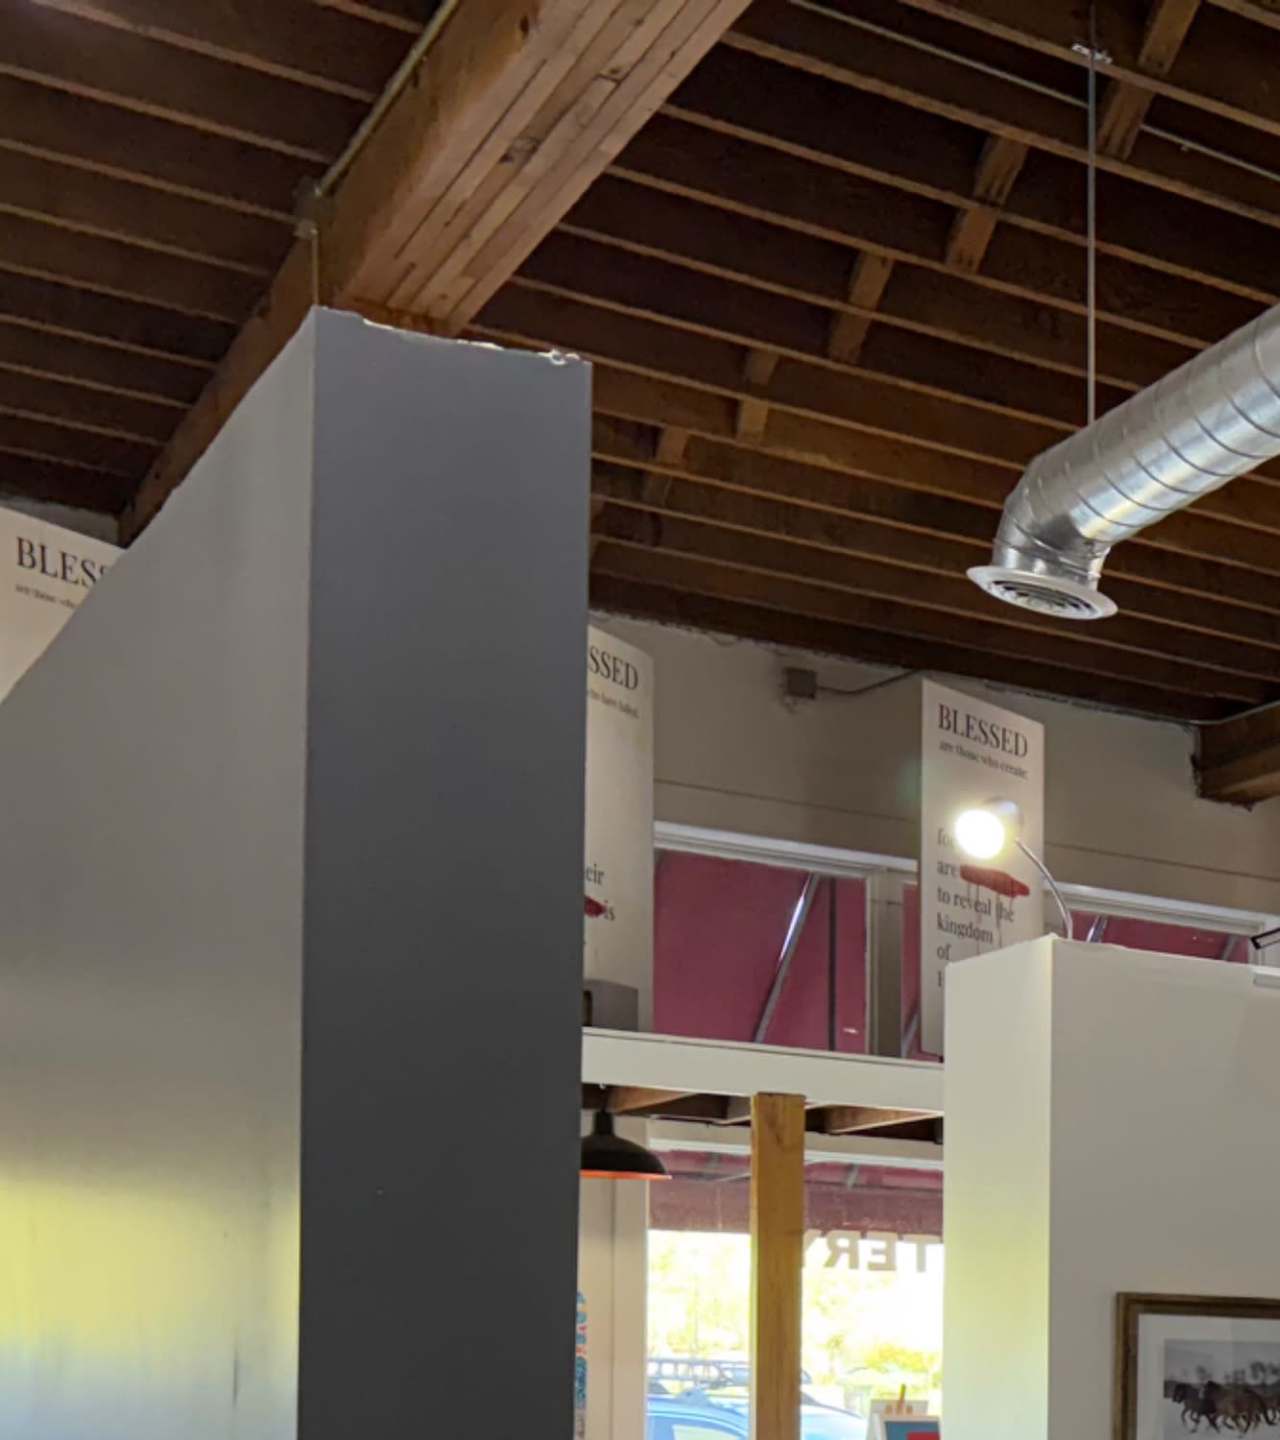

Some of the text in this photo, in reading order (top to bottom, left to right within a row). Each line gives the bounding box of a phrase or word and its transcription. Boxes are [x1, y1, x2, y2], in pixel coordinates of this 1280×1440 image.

[17, 536, 105, 589] BLES
[590, 645, 639, 690] SSED
[938, 703, 1028, 758] BLESSED
[937, 886, 951, 904] to
[953, 893, 991, 915] reveal
[937, 912, 993, 945] kingdom
[937, 944, 952, 961] of
